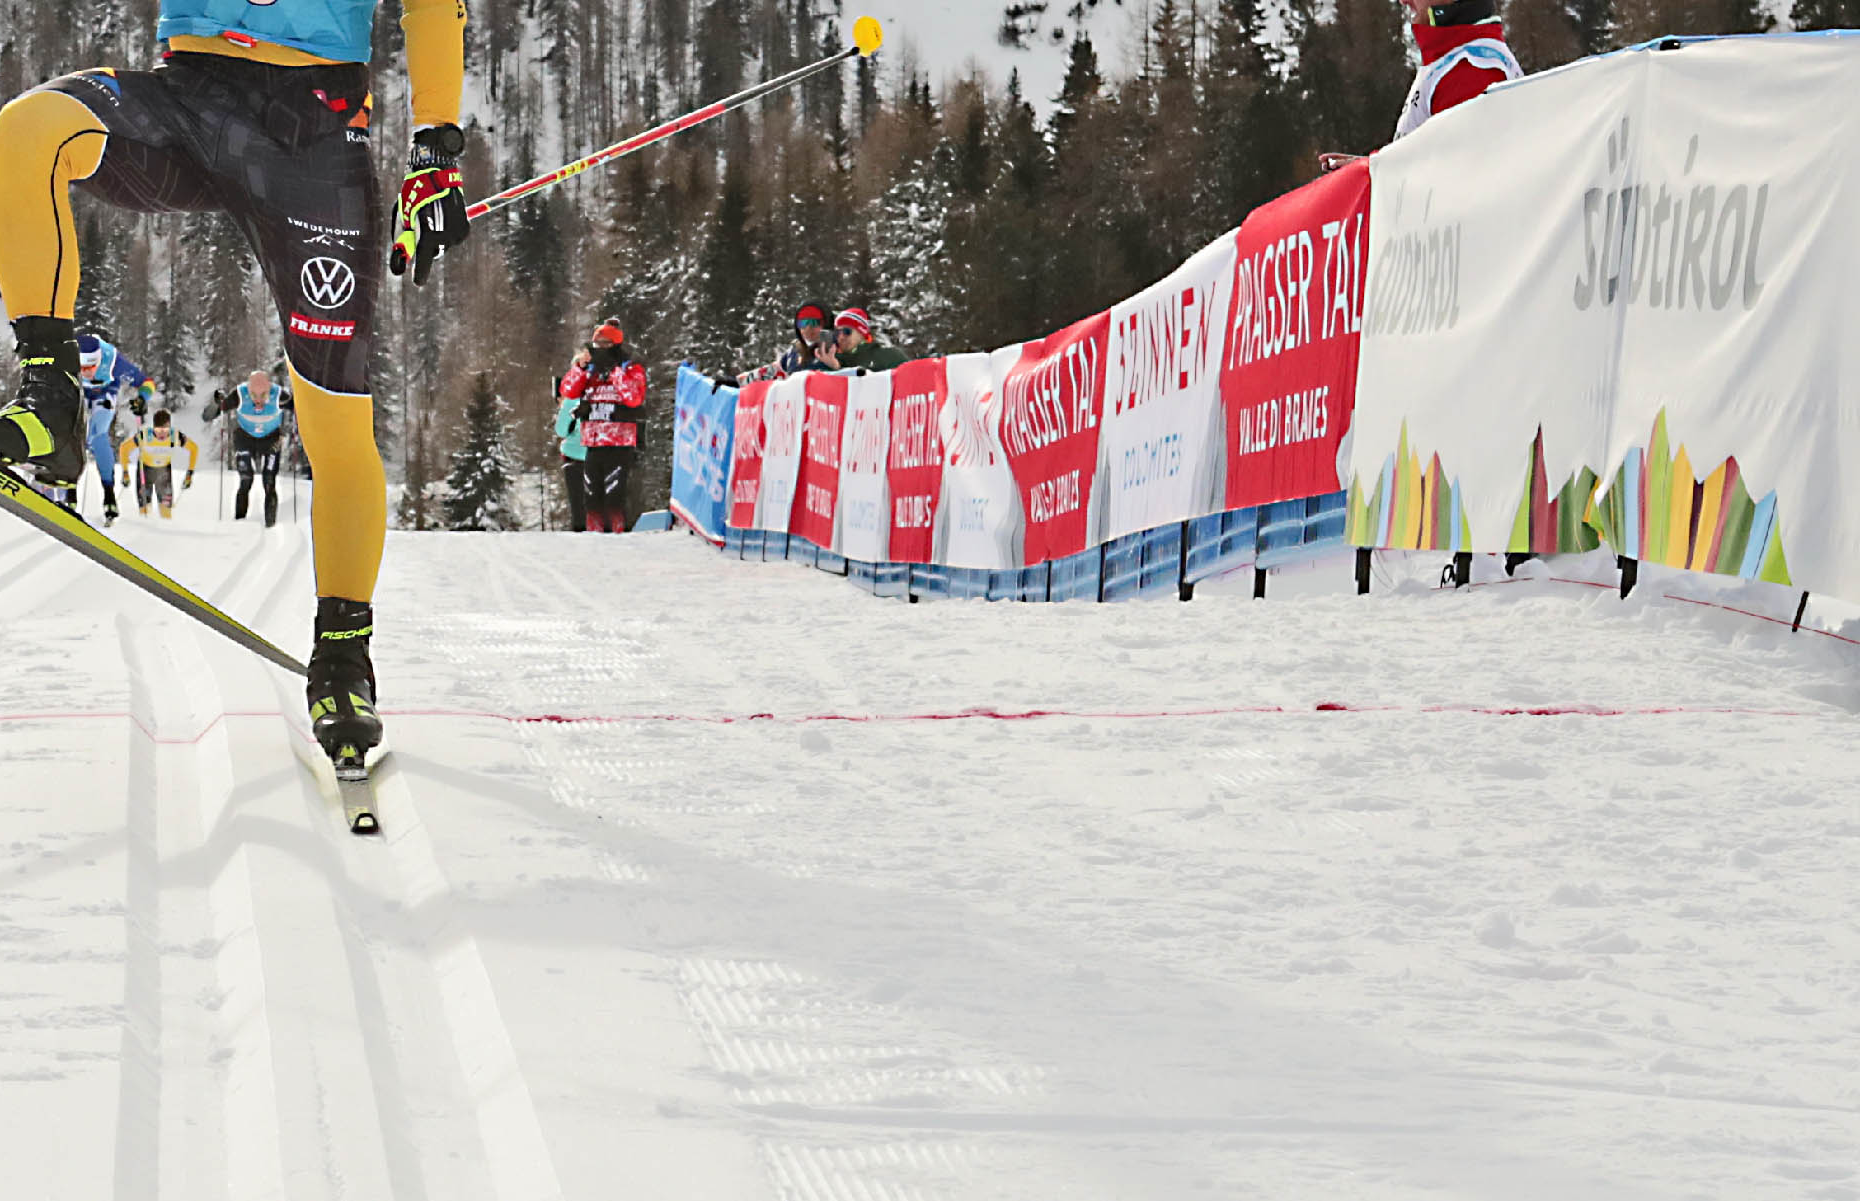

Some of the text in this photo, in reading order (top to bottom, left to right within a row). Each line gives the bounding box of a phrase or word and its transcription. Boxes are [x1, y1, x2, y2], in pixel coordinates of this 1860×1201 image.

[290, 316, 355, 337] FRANKE
[1229, 212, 1363, 371] PRAGSER TAL
